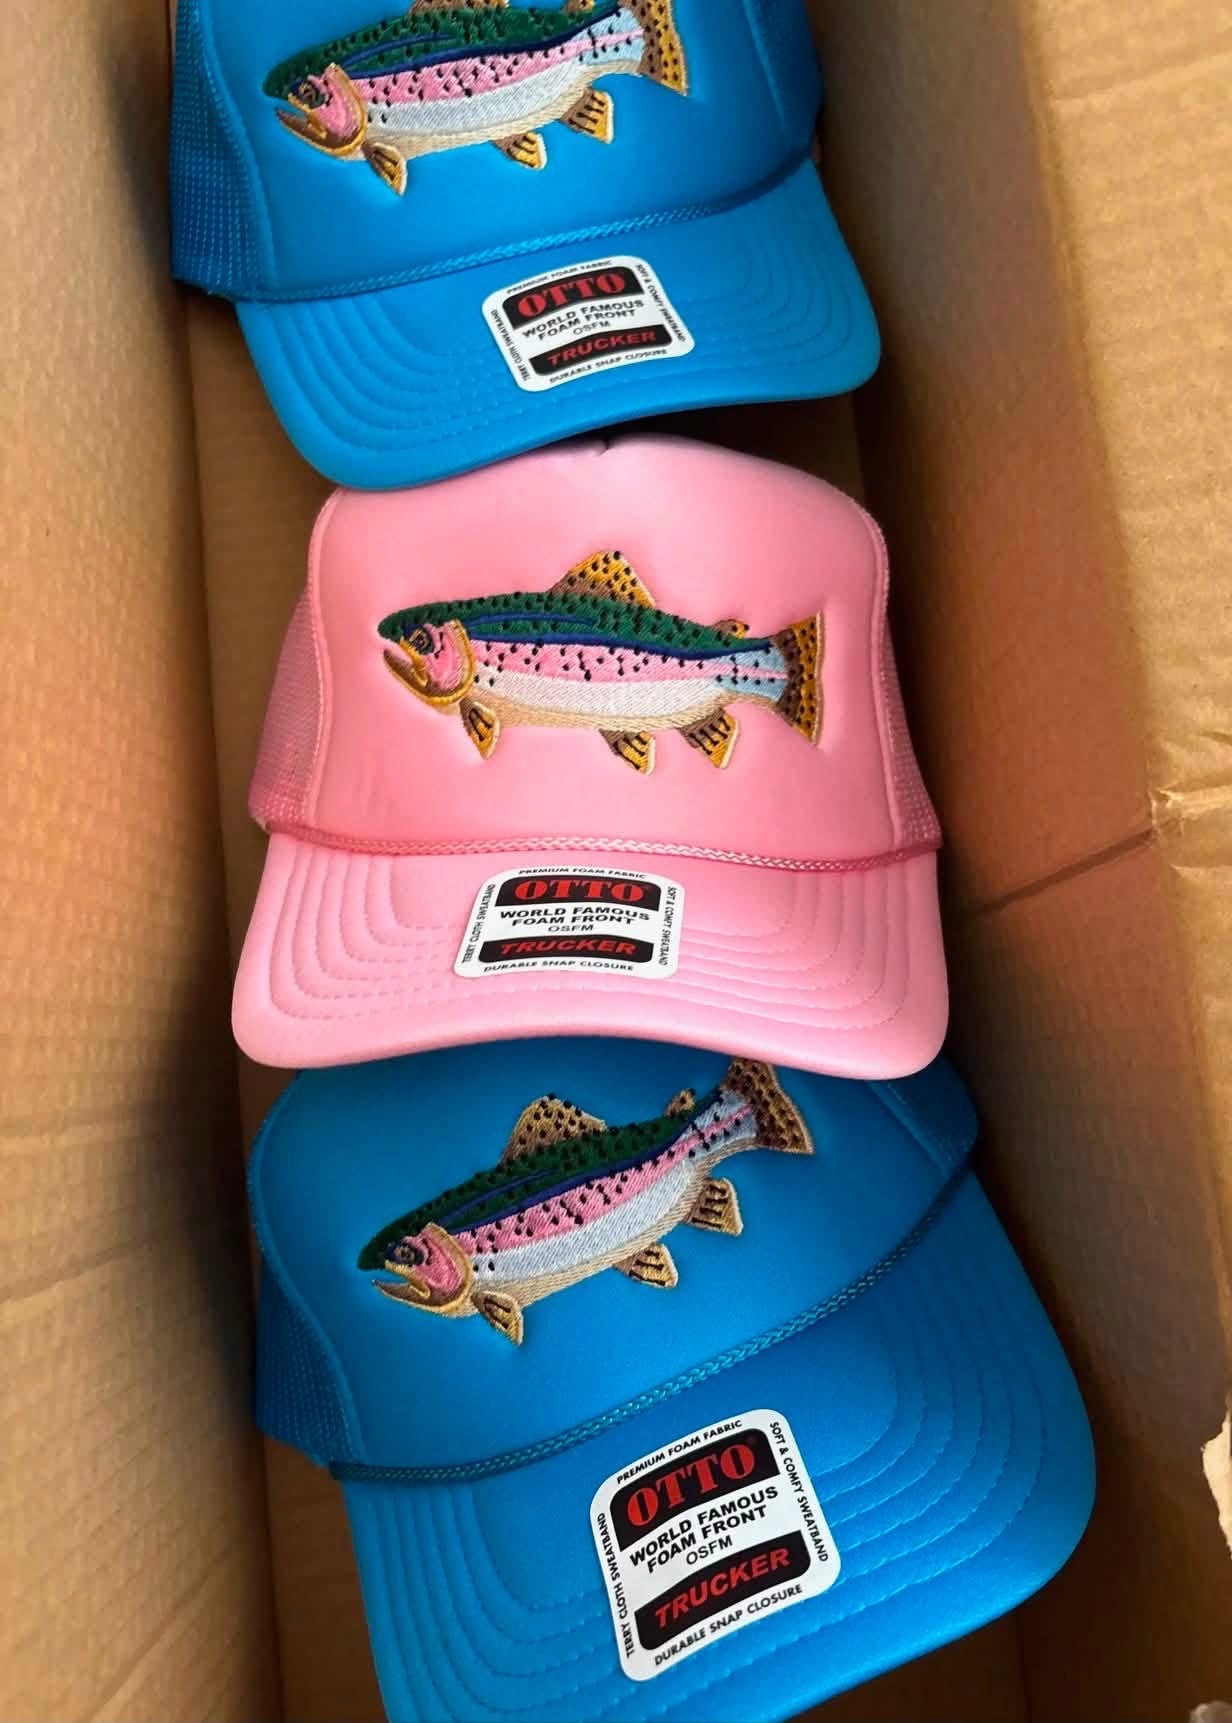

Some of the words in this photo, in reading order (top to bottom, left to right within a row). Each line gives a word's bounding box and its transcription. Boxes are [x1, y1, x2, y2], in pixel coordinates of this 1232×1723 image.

[518, 273, 625, 317] OTTO
[523, 311, 577, 338] WORLD
[581, 300, 644, 314] FAMOUS
[538, 318, 581, 340] FOAM
[585, 309, 637, 321] FRONT
[573, 321, 611, 335] OSFM
[547, 331, 657, 366] TRUCKER
[515, 880, 644, 901] OTTO
[608, 870, 647, 879] FABRIC
[500, 908, 567, 918] WORLD
[573, 907, 650, 921] FAMOUS
[512, 917, 564, 926] FOAM
[571, 915, 637, 924] FRONT
[548, 924, 594, 932] OSFM
[501, 940, 637, 955] TRUCKER
[484, 962, 538, 972] DURABLE
[580, 961, 634, 971] CLOSURE
[617, 1452, 665, 1484] PREMIUM
[668, 1437, 701, 1456] FOAM
[703, 1420, 742, 1439] FABRIC
[627, 1444, 755, 1527] OTTO
[770, 1422, 786, 1446] SOFT
[783, 1457, 804, 1495] COMFY
[797, 1496, 829, 1562] SWEATBAND
[630, 1519, 692, 1567] WORLD
[697, 1486, 779, 1525] FAMOUS
[648, 1534, 696, 1574] FOAM
[702, 1506, 767, 1539] FRONT
[597, 1512, 620, 1581] SWEATBAND
[686, 1535, 733, 1565] OSFM
[614, 1585, 628, 1619] CLOTH
[655, 1548, 790, 1628] TRUCKER
[621, 1623, 634, 1658] TERRY
[654, 1630, 706, 1666] DURABLE
[710, 1610, 743, 1634] SNAP
[747, 1584, 803, 1614] CLOSURE
